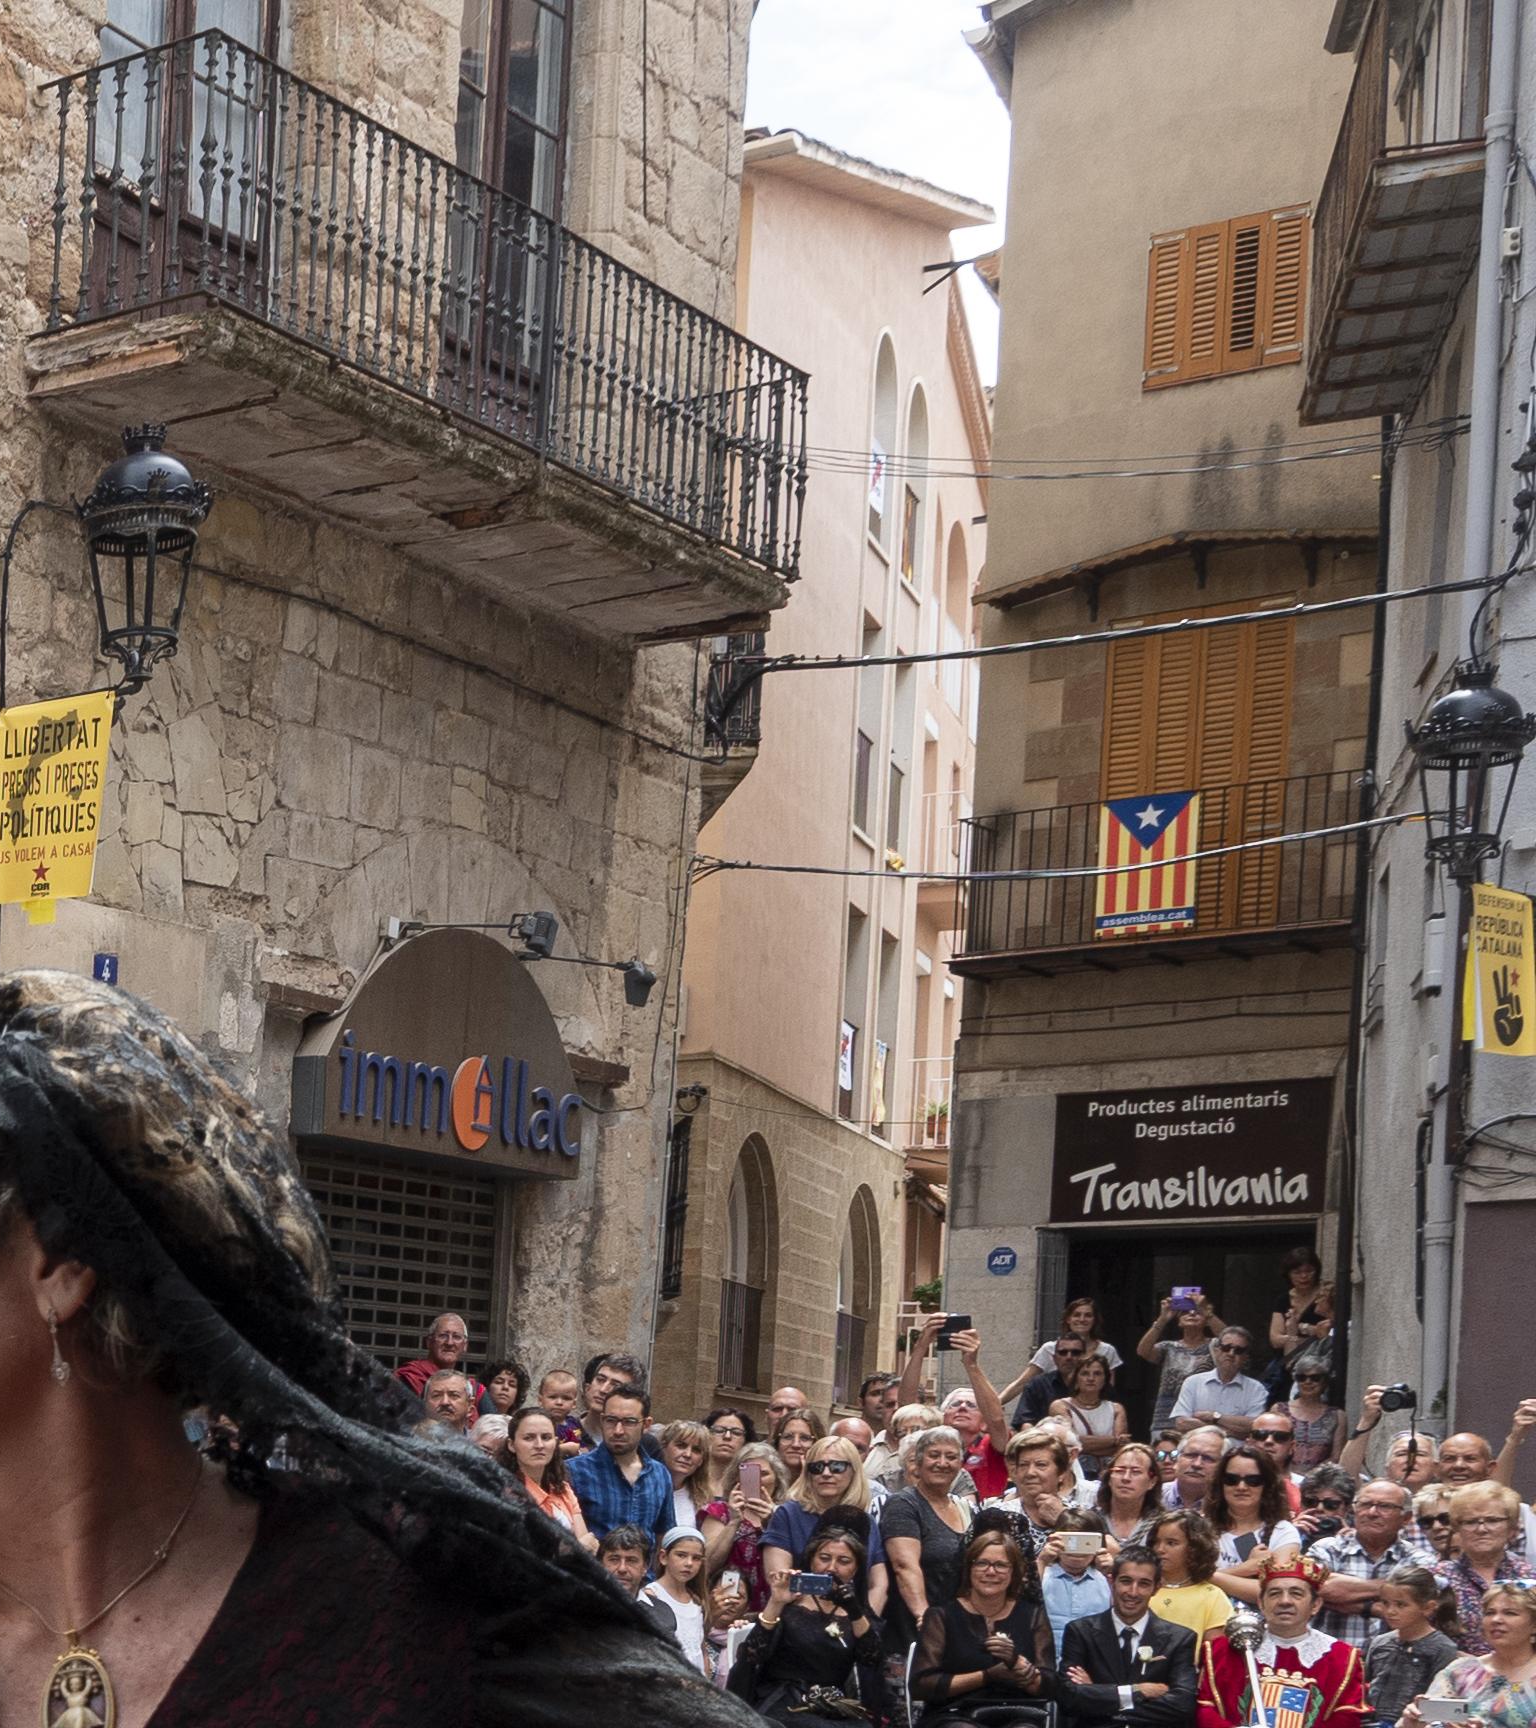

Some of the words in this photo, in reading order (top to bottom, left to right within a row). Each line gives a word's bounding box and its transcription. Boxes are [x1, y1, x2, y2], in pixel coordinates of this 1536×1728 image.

[4, 717, 102, 760] LLIBERTAT
[1, 766, 42, 801] PRESOS
[45, 765, 50, 795] I
[54, 760, 99, 793] PRESES
[14, 846, 46, 863] VOLEM
[50, 845, 58, 859] A
[31, 882, 50, 892] CDR
[1101, 910, 1187, 927] assemblea.cat
[1476, 913, 1524, 938] REPÚBLICA
[102, 958, 111, 981] 4
[1087, 1099, 1176, 1118] Productes
[1180, 1090, 1289, 1112] alimentaris
[1134, 1117, 1236, 1141] Degustació
[1069, 1162, 1309, 1215] Transilvania
[991, 1254, 1014, 1266] ADT
